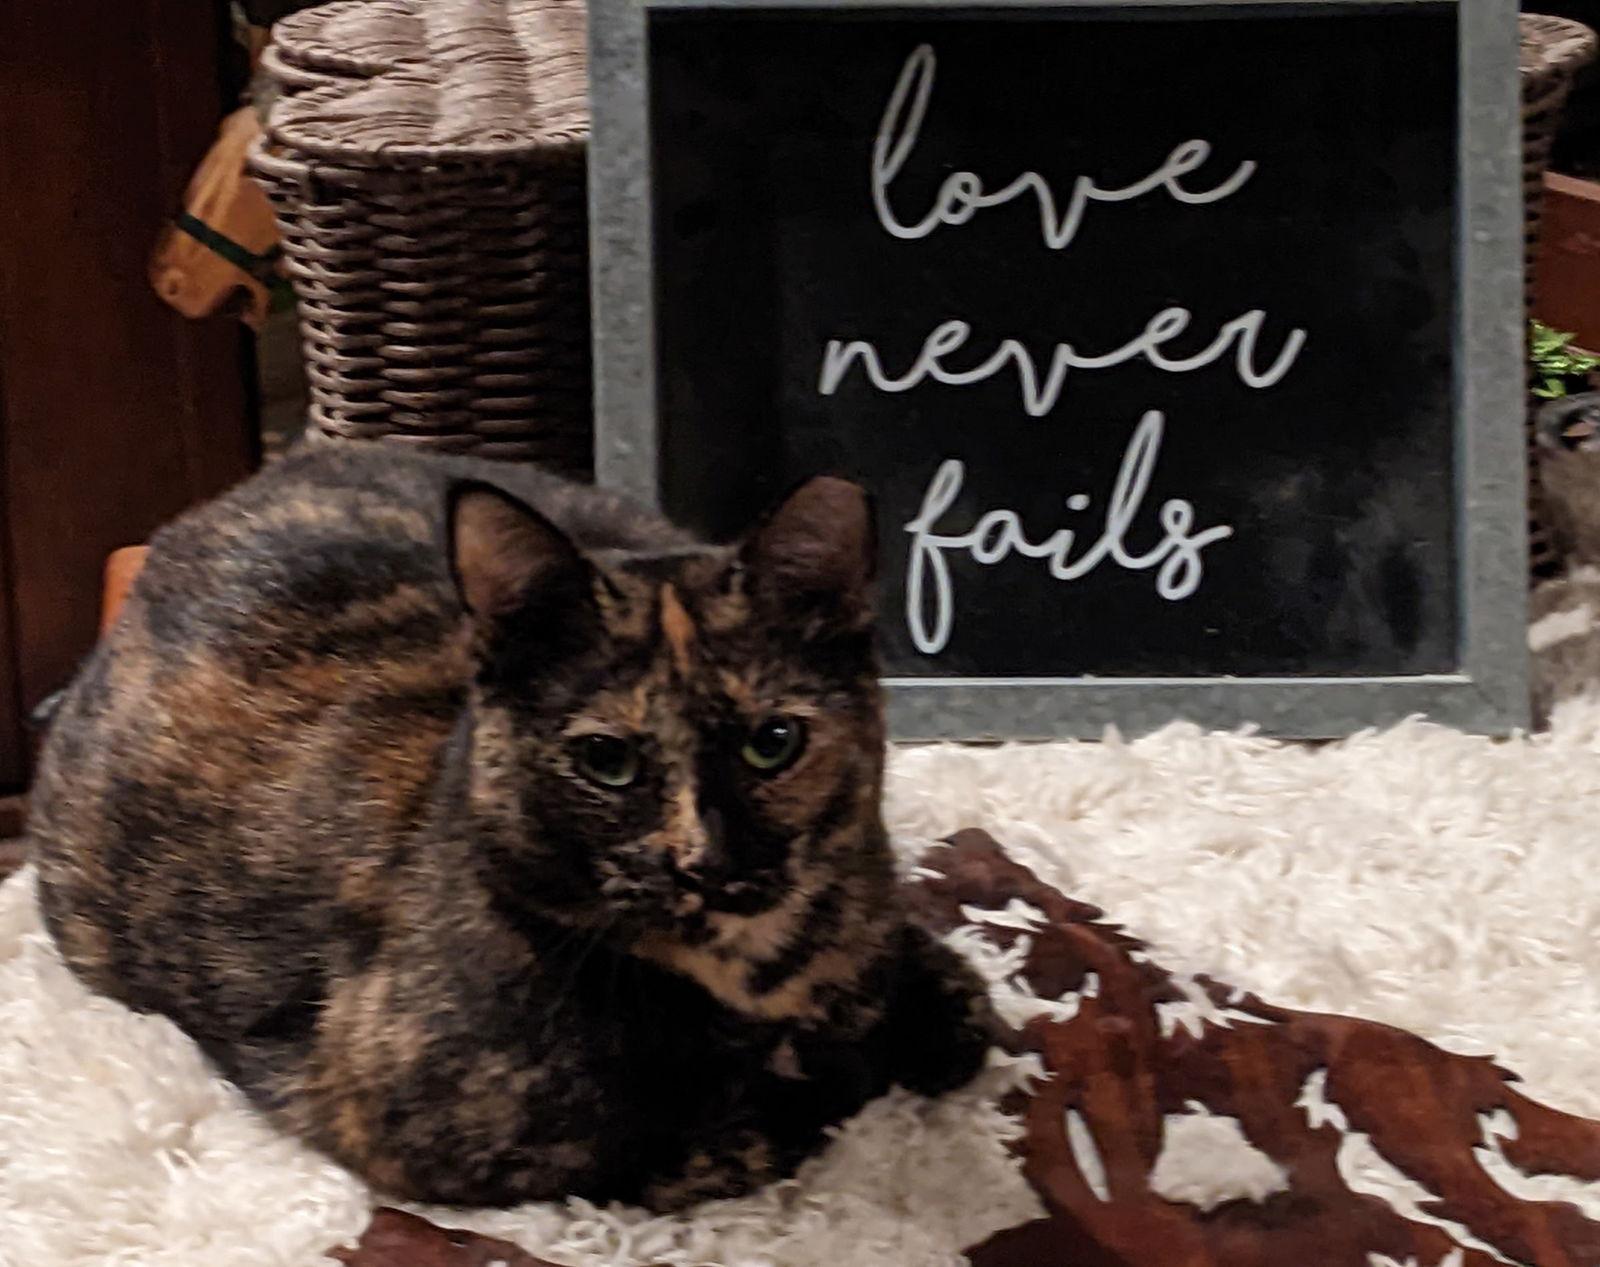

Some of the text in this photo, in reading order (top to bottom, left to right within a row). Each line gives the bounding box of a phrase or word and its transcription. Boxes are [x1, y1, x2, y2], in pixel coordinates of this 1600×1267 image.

[873, 43, 1256, 250] love
[819, 306, 1306, 418] never
[904, 410, 1233, 655] fails
